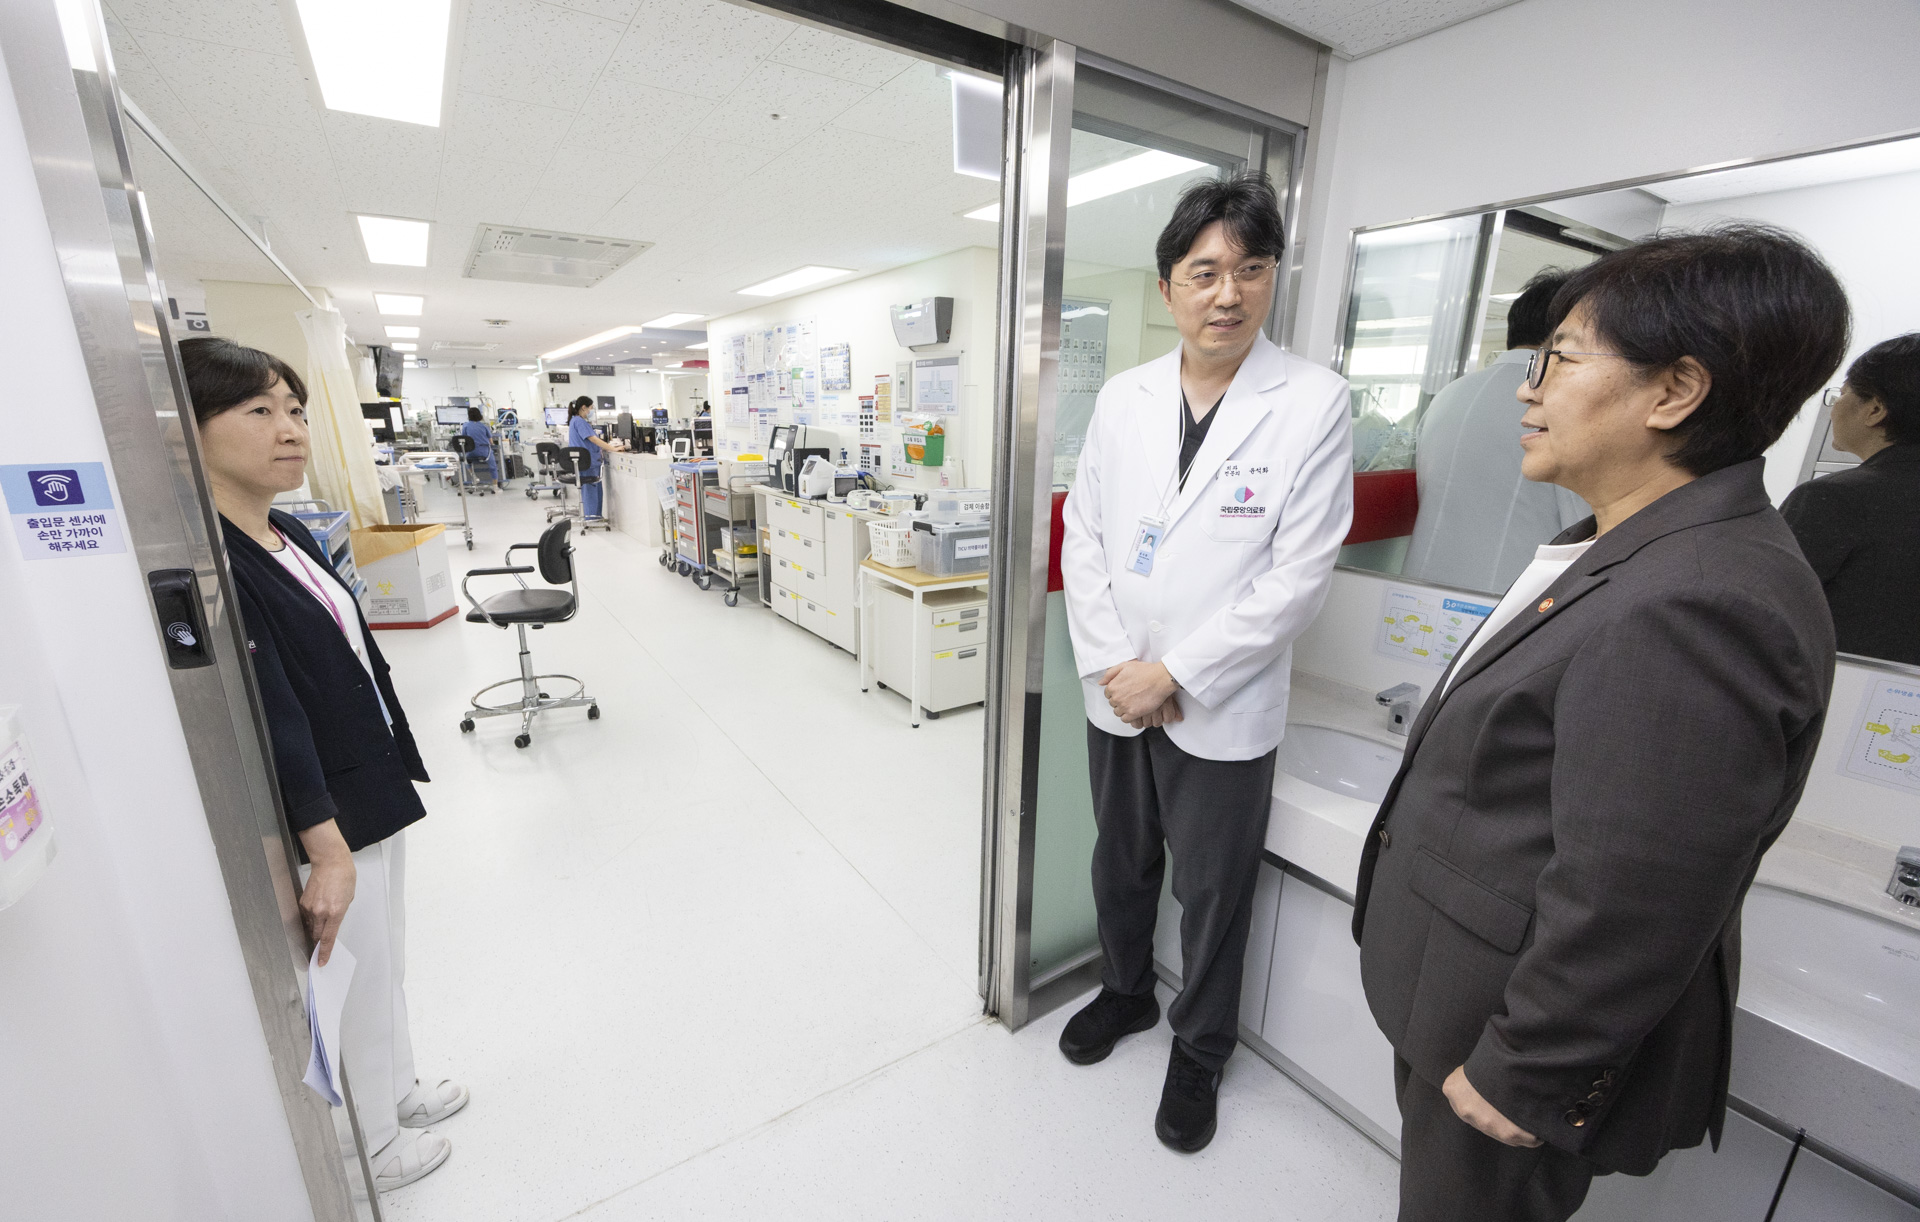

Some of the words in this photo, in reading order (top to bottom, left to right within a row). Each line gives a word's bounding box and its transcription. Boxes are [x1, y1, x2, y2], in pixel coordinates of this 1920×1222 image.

[418, 360, 428, 368] 13
[27, 517, 65, 528] 출입문
[68, 514, 106, 526] 센서에
[37, 530, 62, 540] 손만
[66, 527, 103, 538] 가까이
[48, 540, 99, 552] 해주세요
